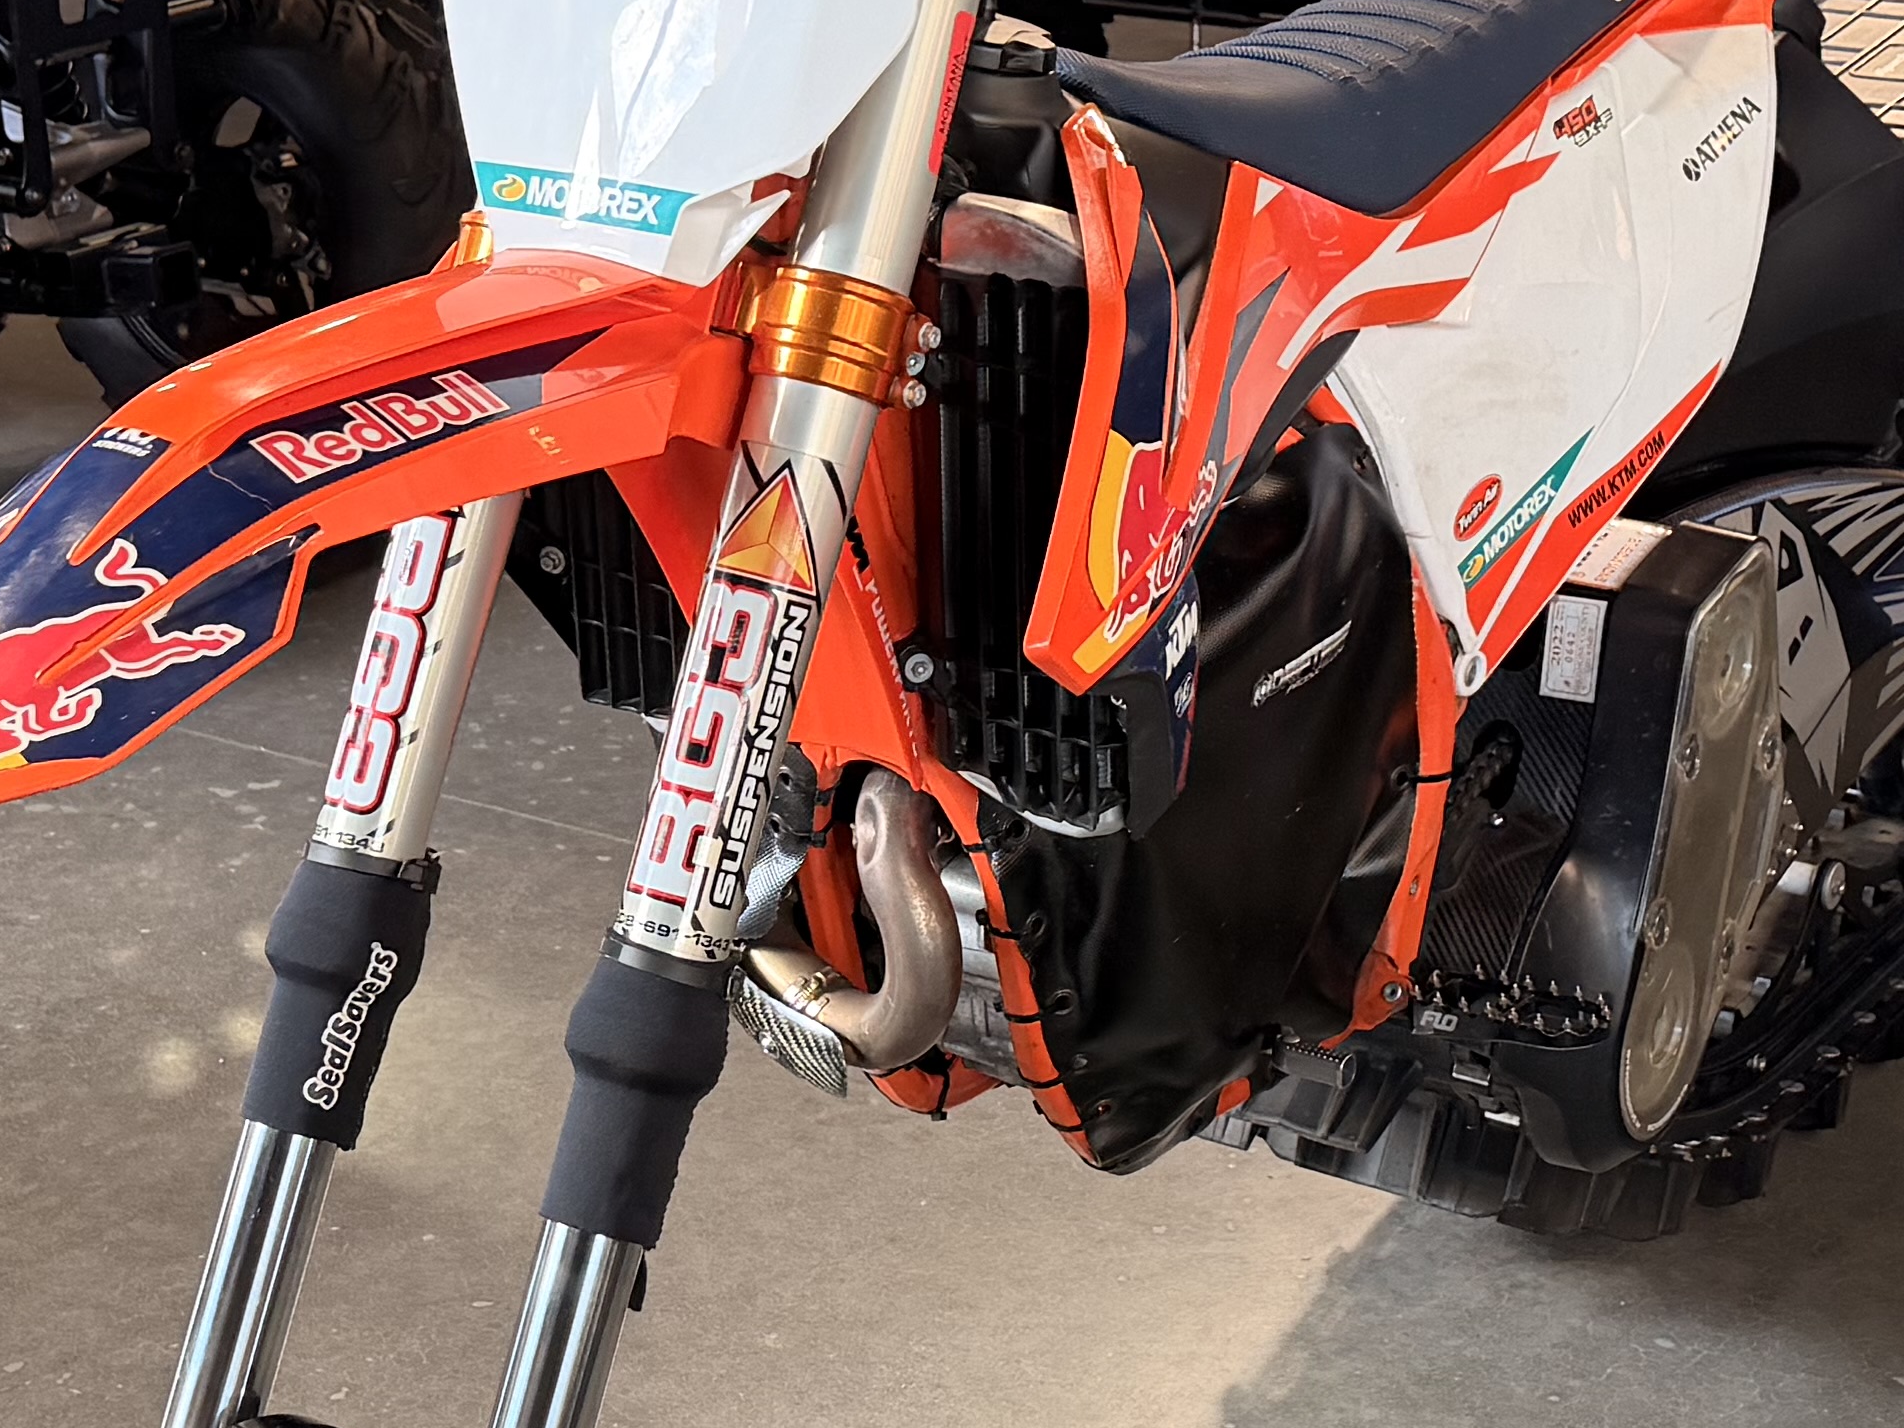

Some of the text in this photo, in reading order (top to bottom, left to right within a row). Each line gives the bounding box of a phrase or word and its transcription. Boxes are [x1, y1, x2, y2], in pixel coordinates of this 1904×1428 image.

[1553, 95, 1599, 139] 450
[1696, 97, 1762, 171] ATHENA
[1483, 476, 1557, 561] MOTOREX
[1568, 431, 1665, 528] WWW.KTM.COM
[1551, 625, 1564, 666] 2022
[627, 577, 778, 908] RG3
[709, 601, 813, 910] SUSPENSION
[303, 944, 397, 1110] SealSavers
